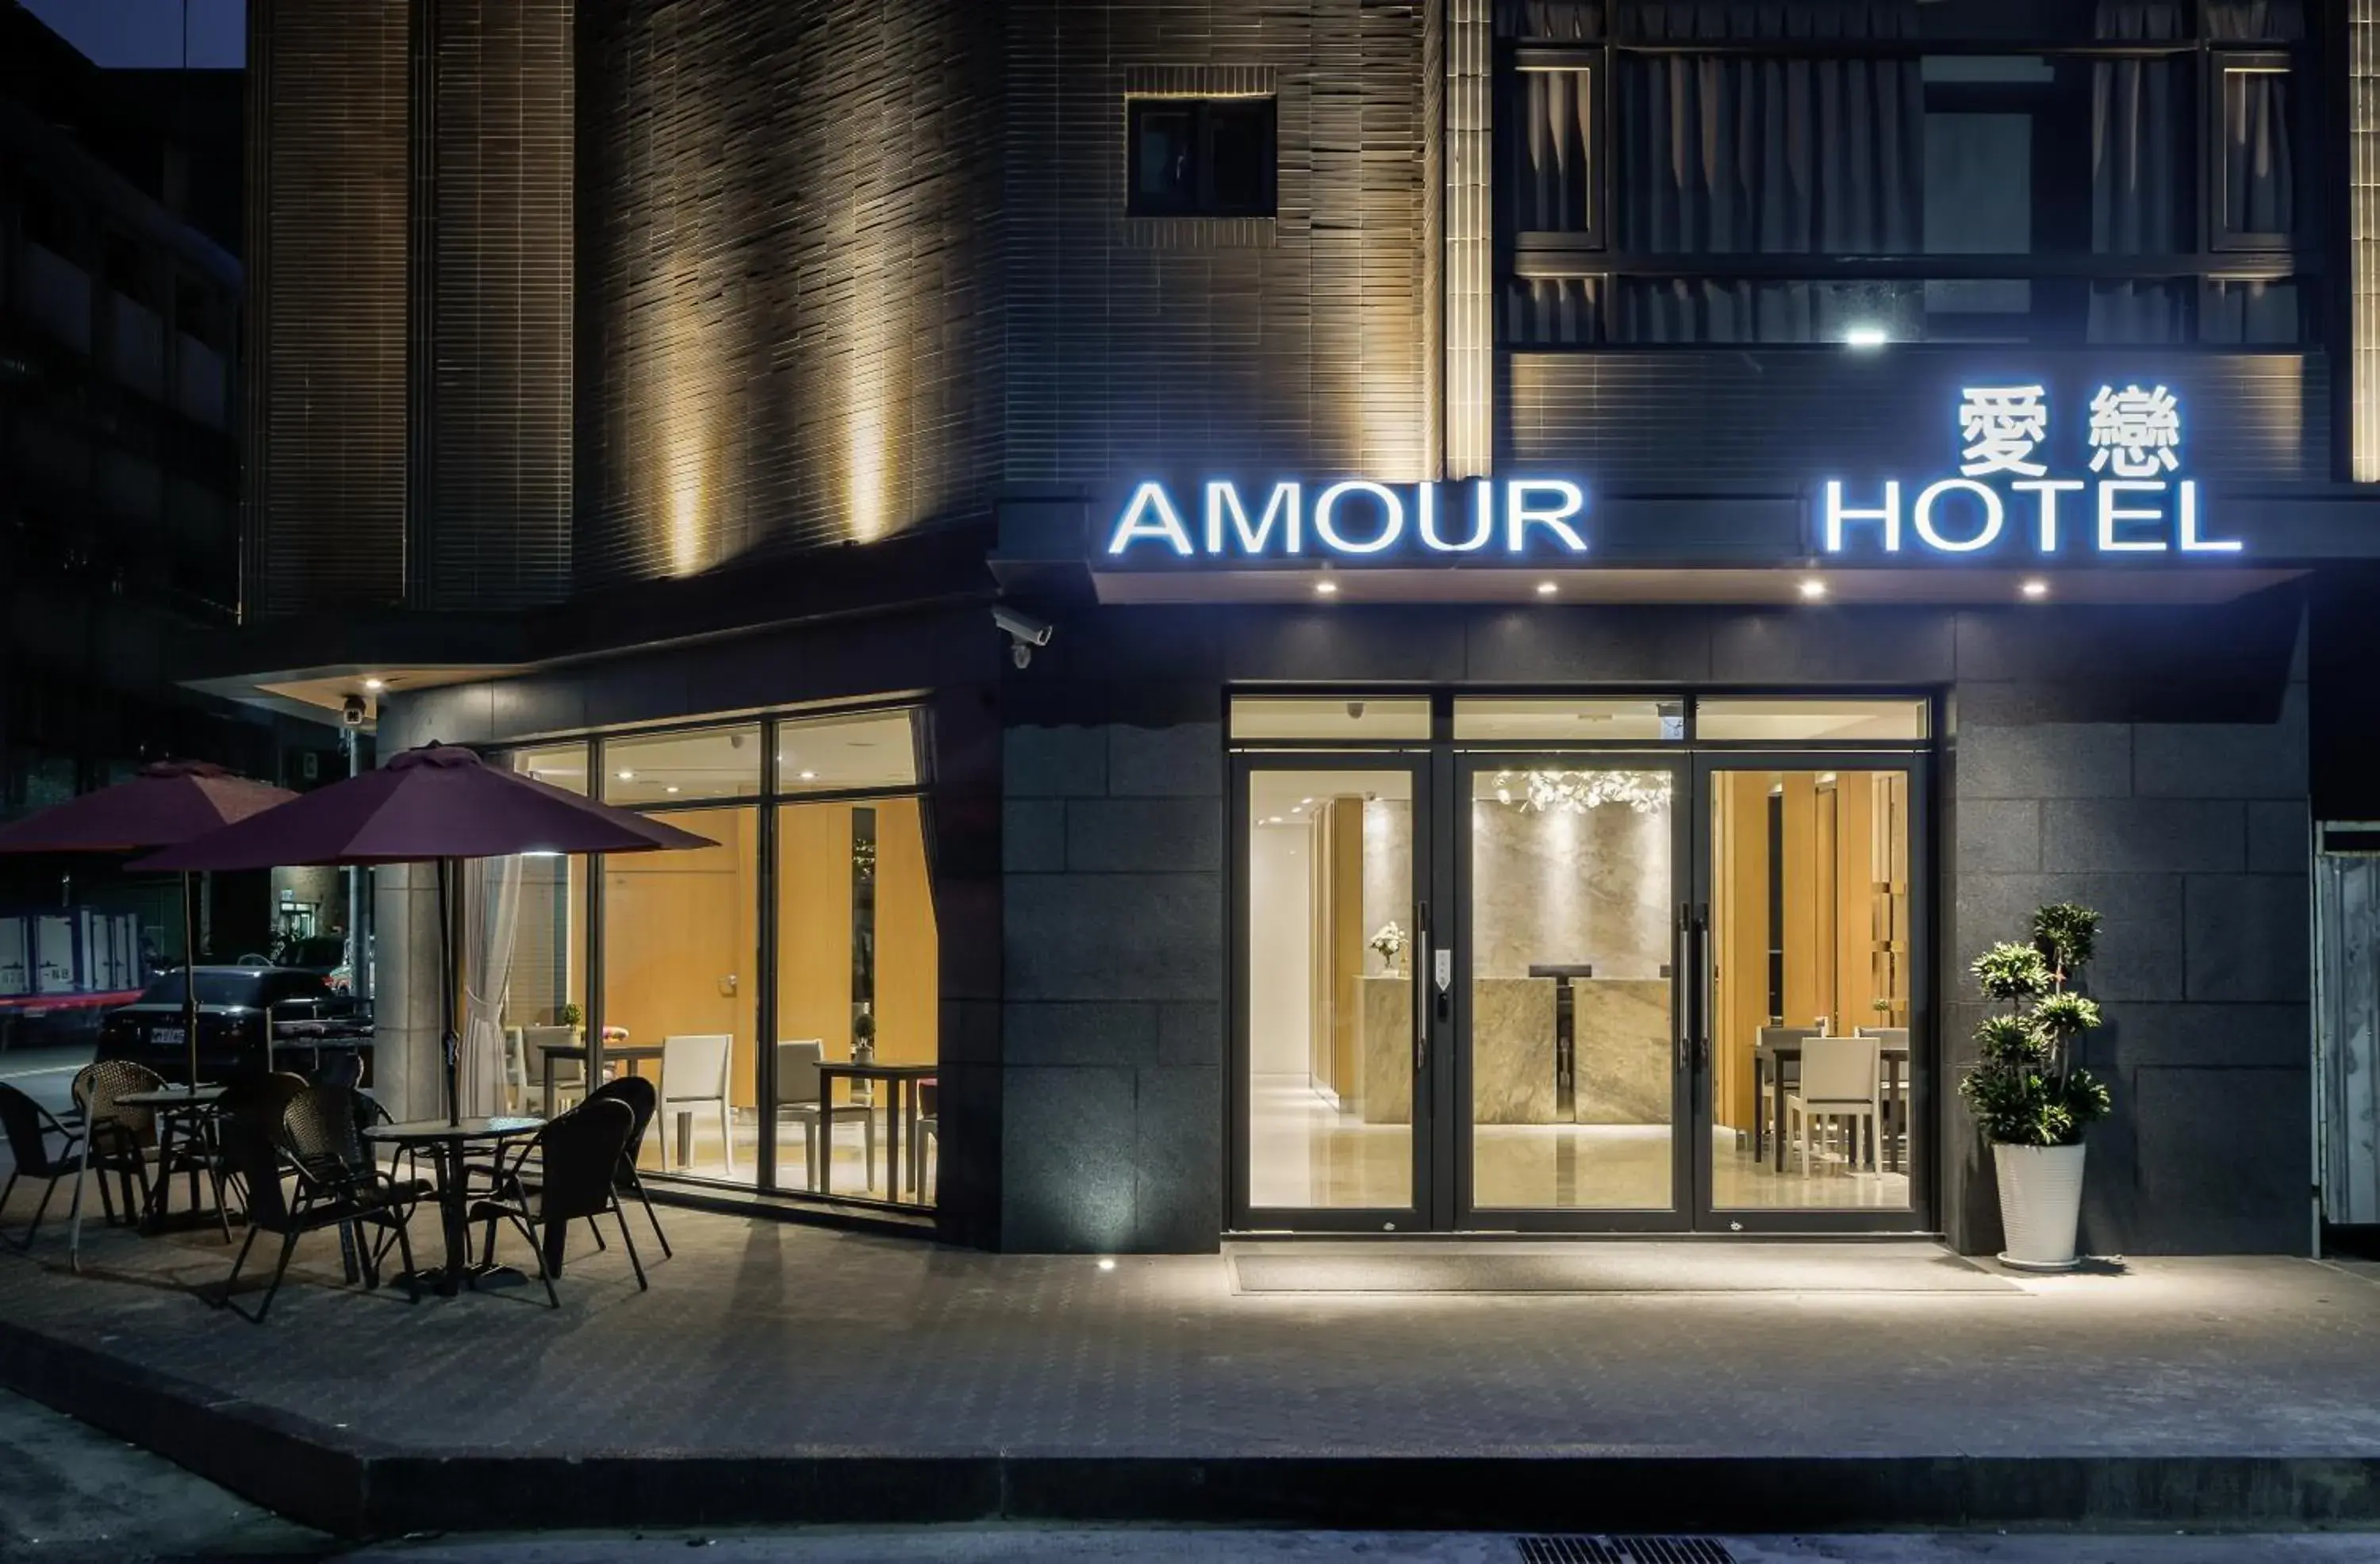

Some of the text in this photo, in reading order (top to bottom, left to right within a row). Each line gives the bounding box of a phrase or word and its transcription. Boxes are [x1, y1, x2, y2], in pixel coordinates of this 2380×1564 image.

[1960, 385, 2179, 477] 愛戀
[1108, 478, 2243, 554] AMOUR HOTEL
